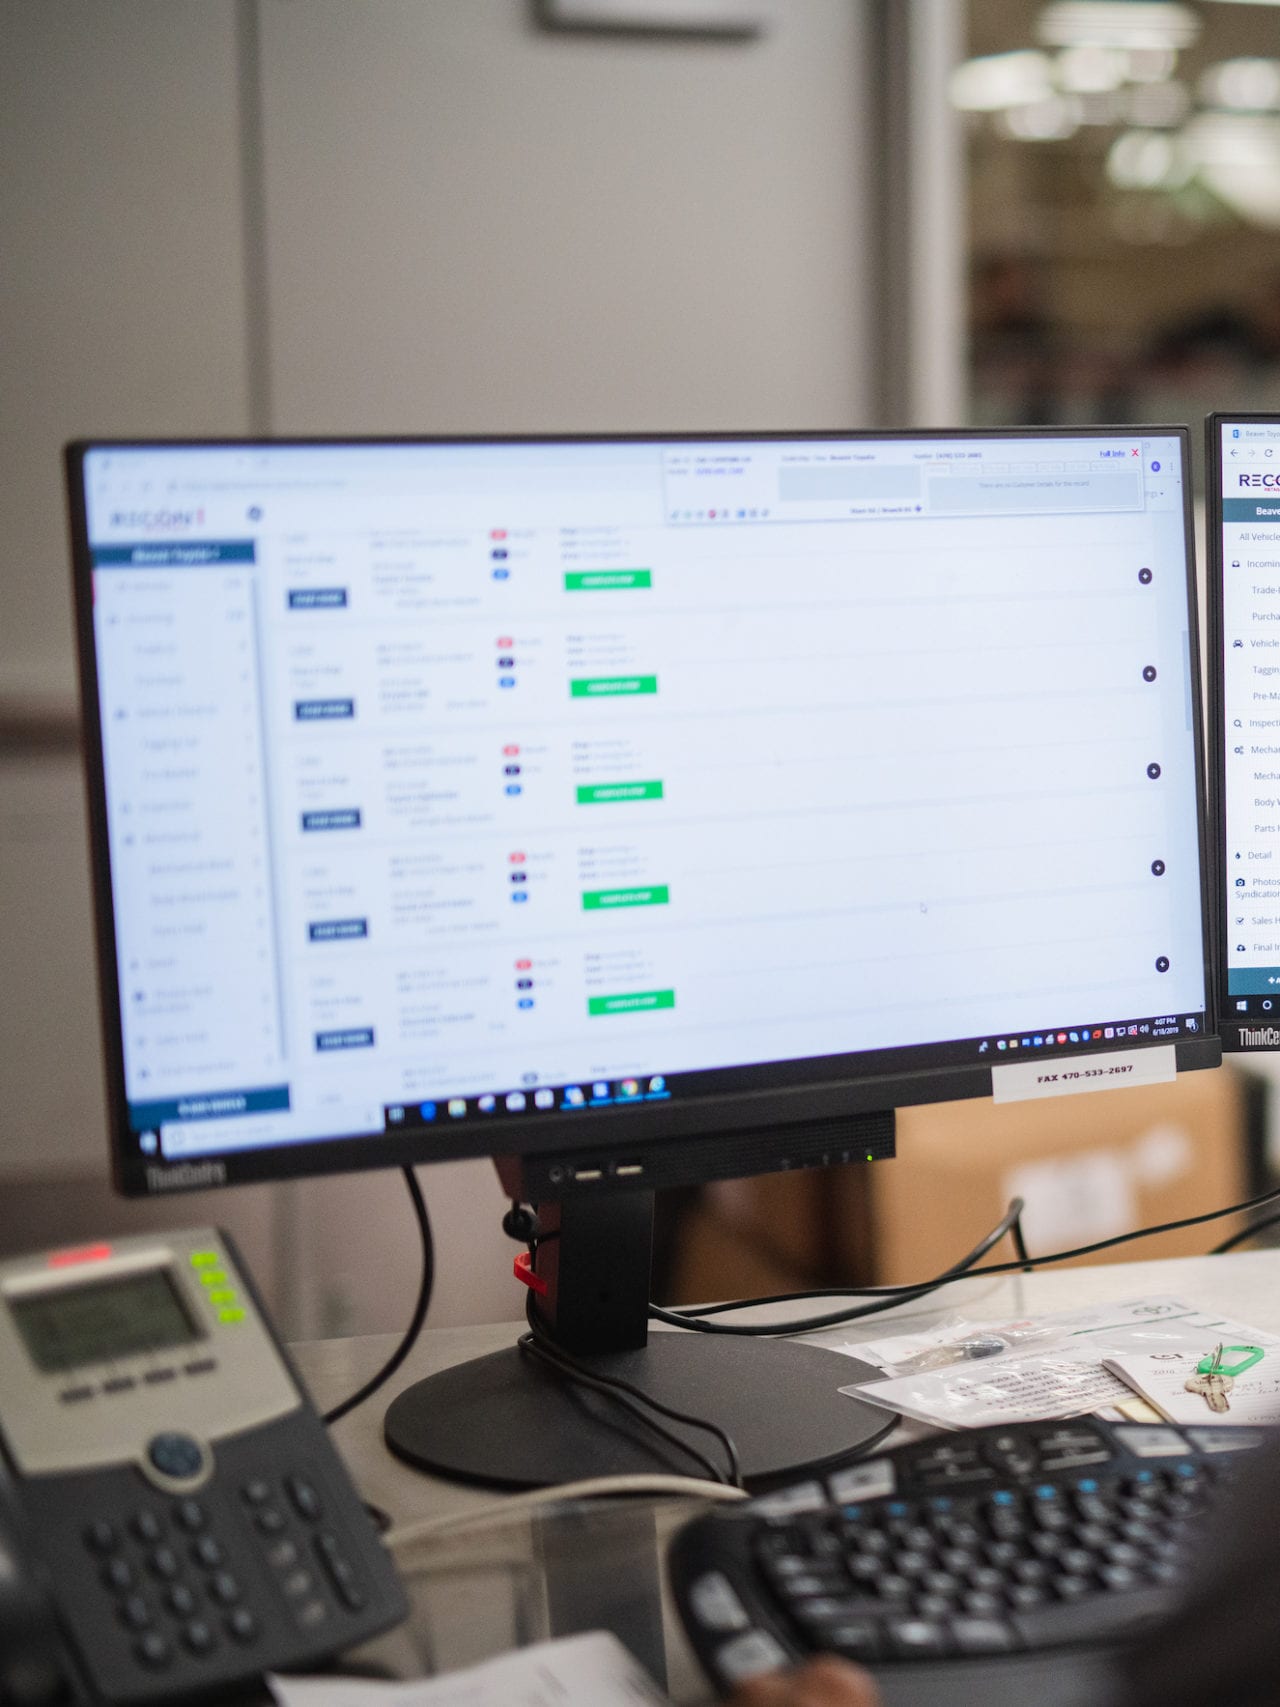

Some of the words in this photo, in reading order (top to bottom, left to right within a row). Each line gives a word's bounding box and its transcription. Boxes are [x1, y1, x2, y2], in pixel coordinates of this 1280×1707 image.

[1100, 450, 1111, 458] Full
[1112, 450, 1126, 458] Info
[1240, 532, 1250, 541] All
[1250, 639, 1280, 648] Vehicle
[1254, 798, 1275, 808] Body
[1254, 824, 1276, 833] Parts
[1248, 851, 1272, 860] Detail
[1252, 877, 1280, 886] Photos
[1252, 916, 1273, 926] Sales
[1253, 943, 1273, 952] Final
[1166, 1016, 1177, 1024] PM
[1037, 1074, 1059, 1083] FAX
[1062, 1065, 1134, 1081] 470-533-2697
